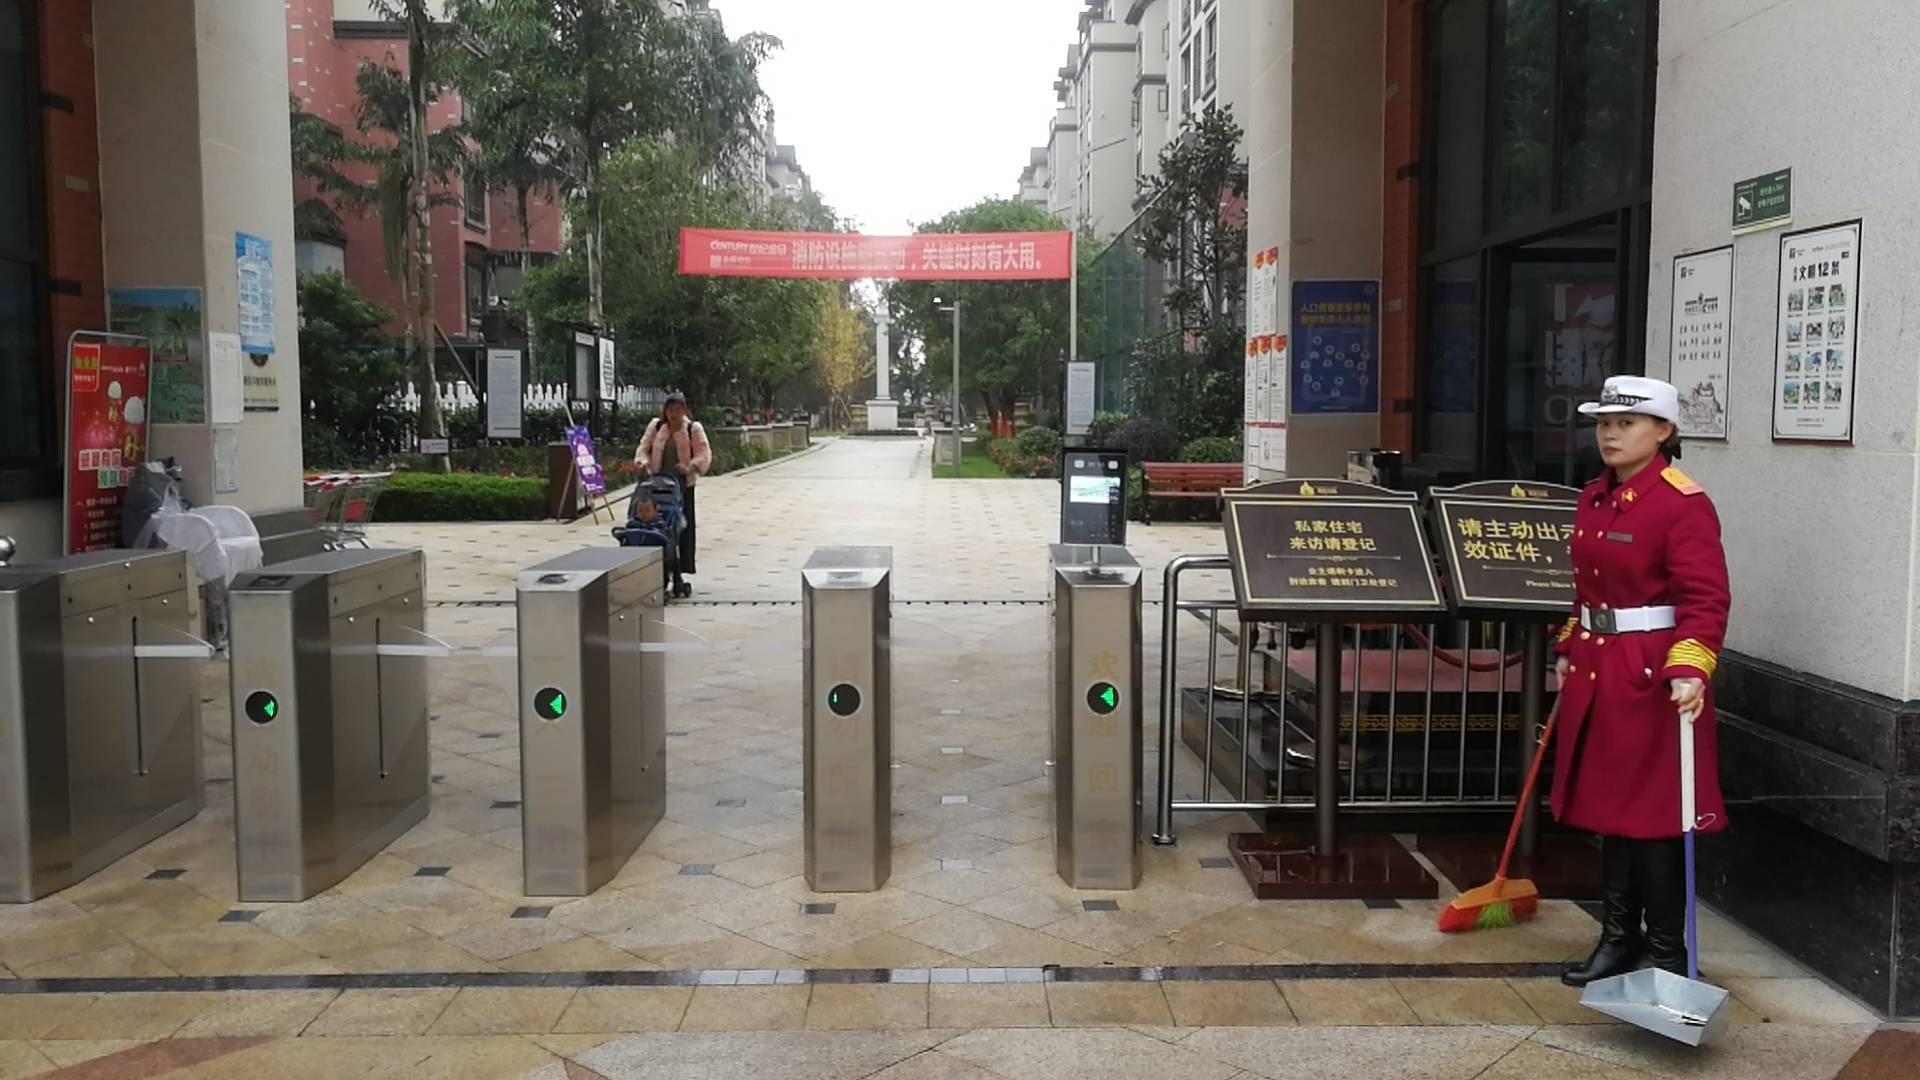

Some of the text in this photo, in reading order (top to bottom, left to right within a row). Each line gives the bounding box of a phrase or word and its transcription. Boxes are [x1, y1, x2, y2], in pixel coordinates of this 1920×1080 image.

[792, 239, 1041, 271] 消防设施，关键时刻有大用。
[1294, 519, 1363, 534] 私家住宅
[1289, 536, 1377, 551] 来访请登记
